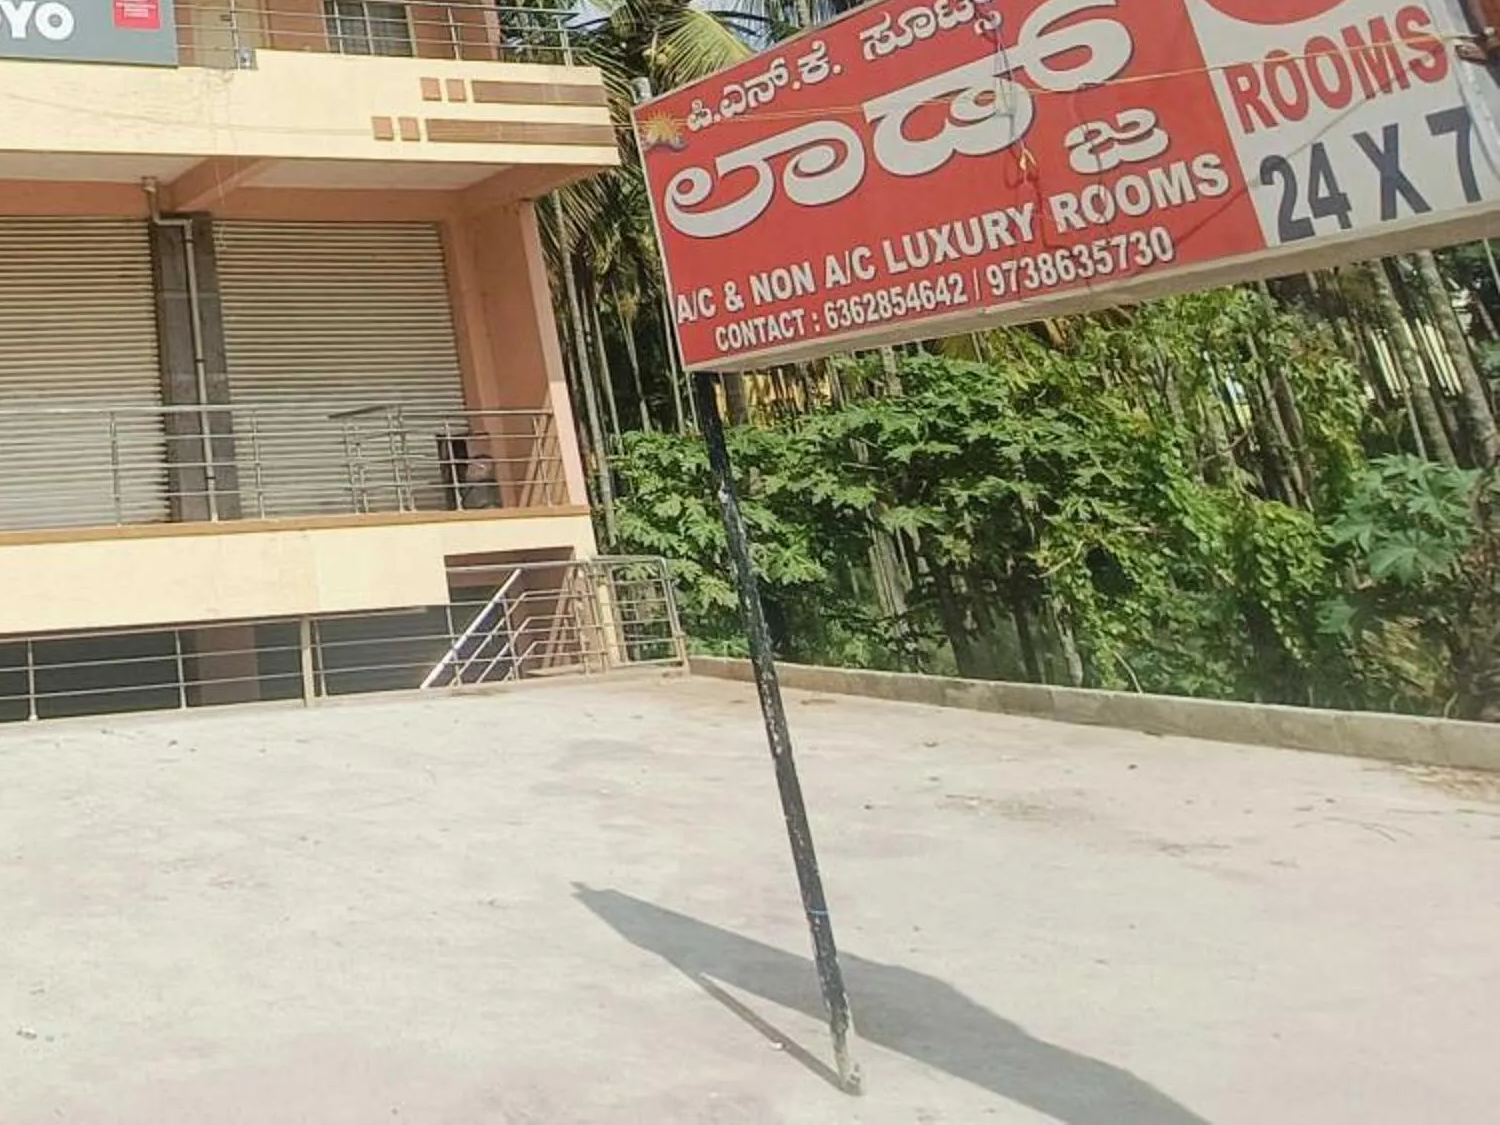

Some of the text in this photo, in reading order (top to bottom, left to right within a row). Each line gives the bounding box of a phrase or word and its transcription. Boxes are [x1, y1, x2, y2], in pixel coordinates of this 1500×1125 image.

[1225, 5, 1449, 134] ROOMS
[677, 153, 1230, 324] A/C & NON A/C LUXURY ROOMS
[1259, 142, 1353, 243] 24
[1425, 105, 1482, 203] 7
[715, 308, 805, 352] CONTACT
[824, 272, 968, 330] 6362854642
[986, 226, 1175, 296] 9738635730
